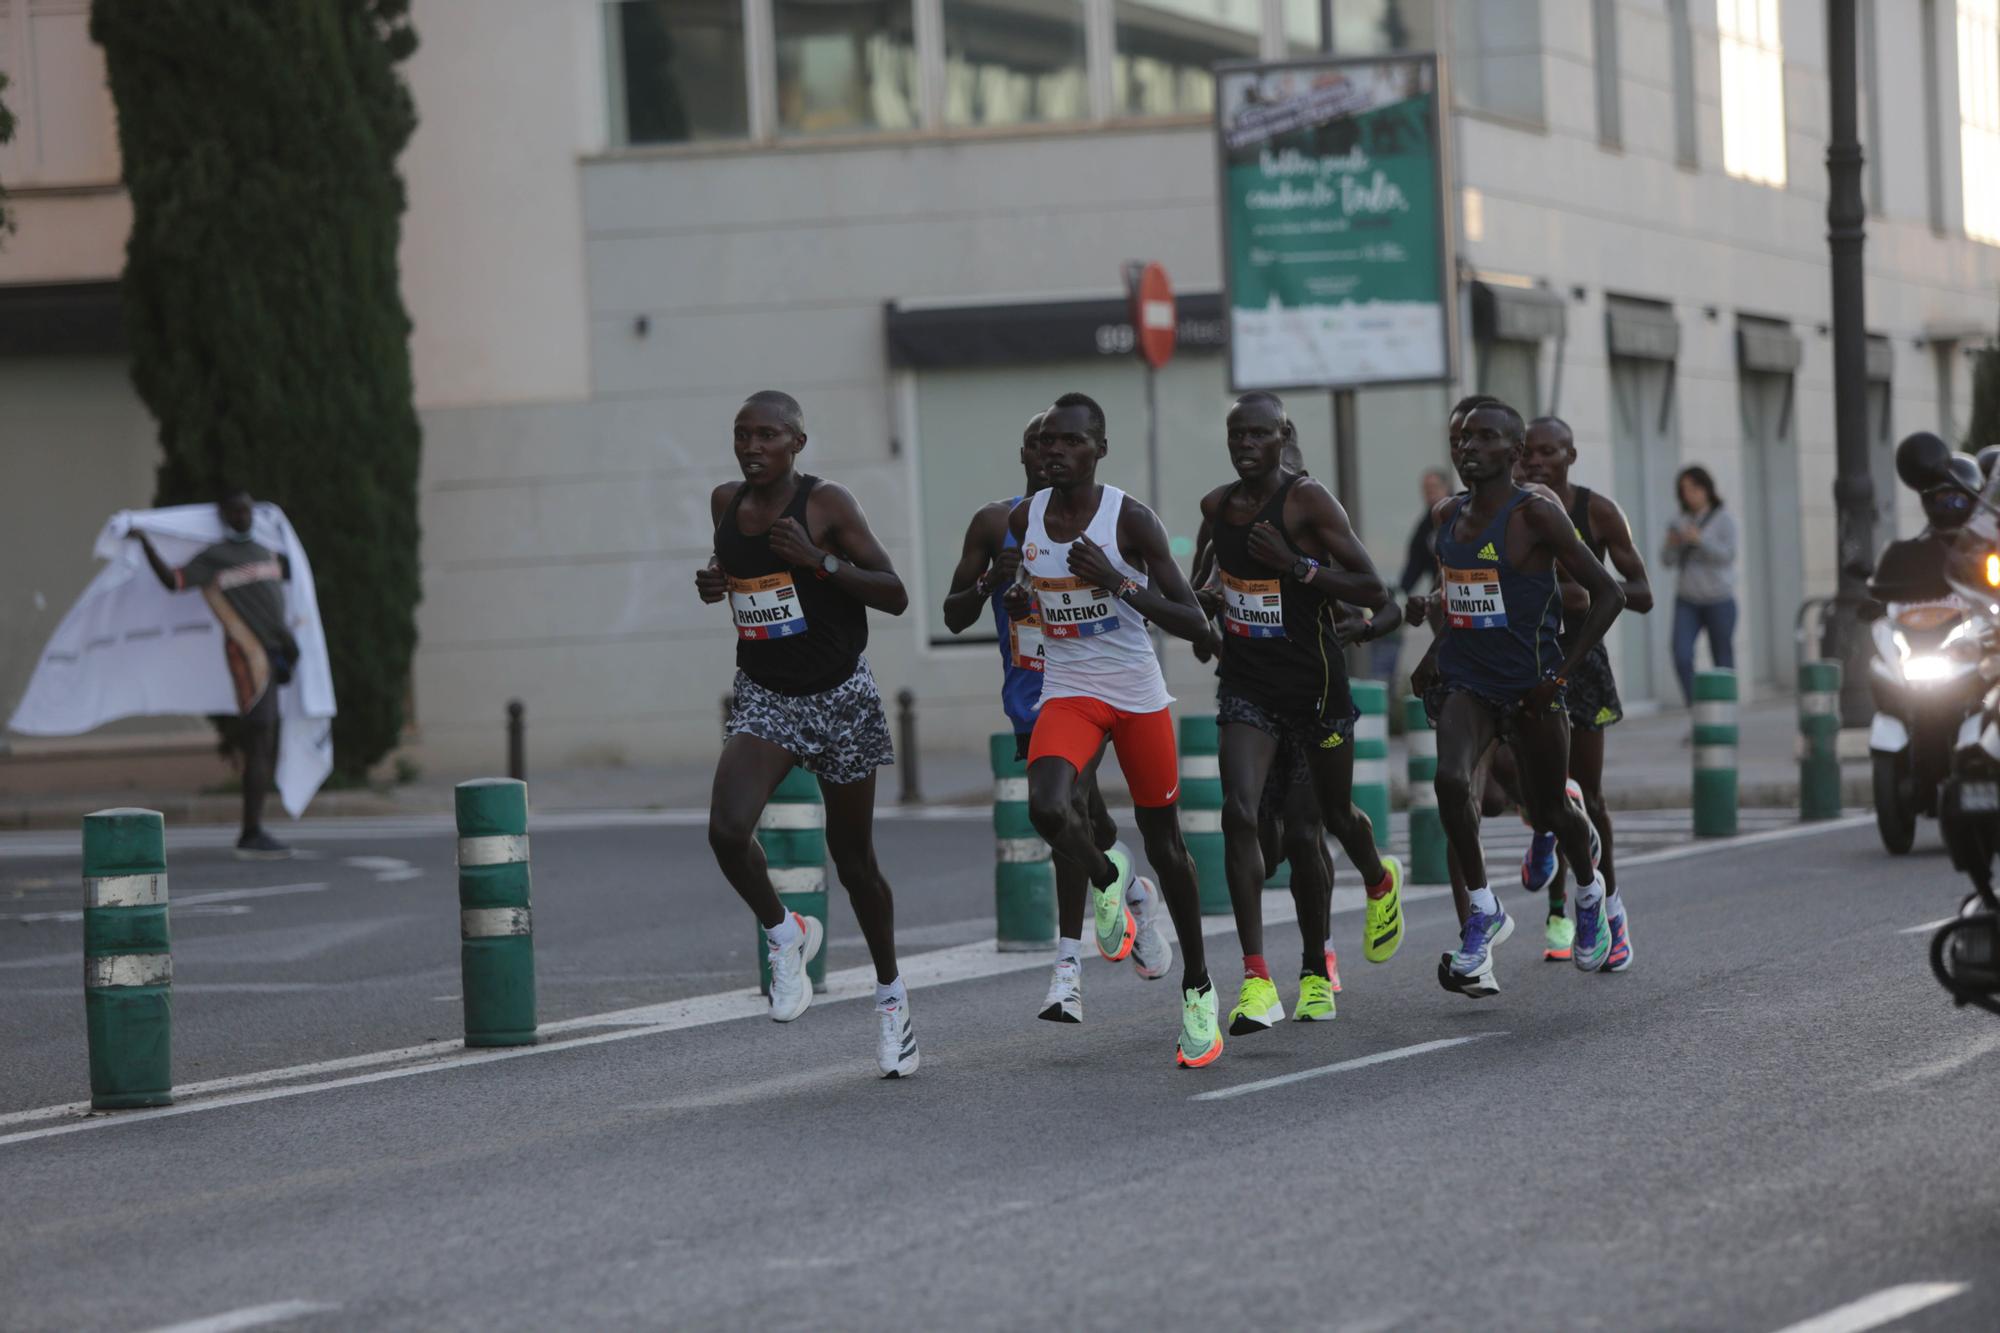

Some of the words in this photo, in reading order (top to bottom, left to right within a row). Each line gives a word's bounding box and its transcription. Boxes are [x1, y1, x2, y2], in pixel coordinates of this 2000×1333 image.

[1039, 548, 1050, 556] NN
[1458, 585, 1471, 597] 14
[748, 595, 757, 607] 1
[1062, 593, 1071, 605] 8
[1238, 594, 1246, 606] 2
[1450, 599, 1495, 613] KIMUTAI
[738, 604, 793, 624] RHONEX
[1045, 603, 1108, 622] MATEIKO
